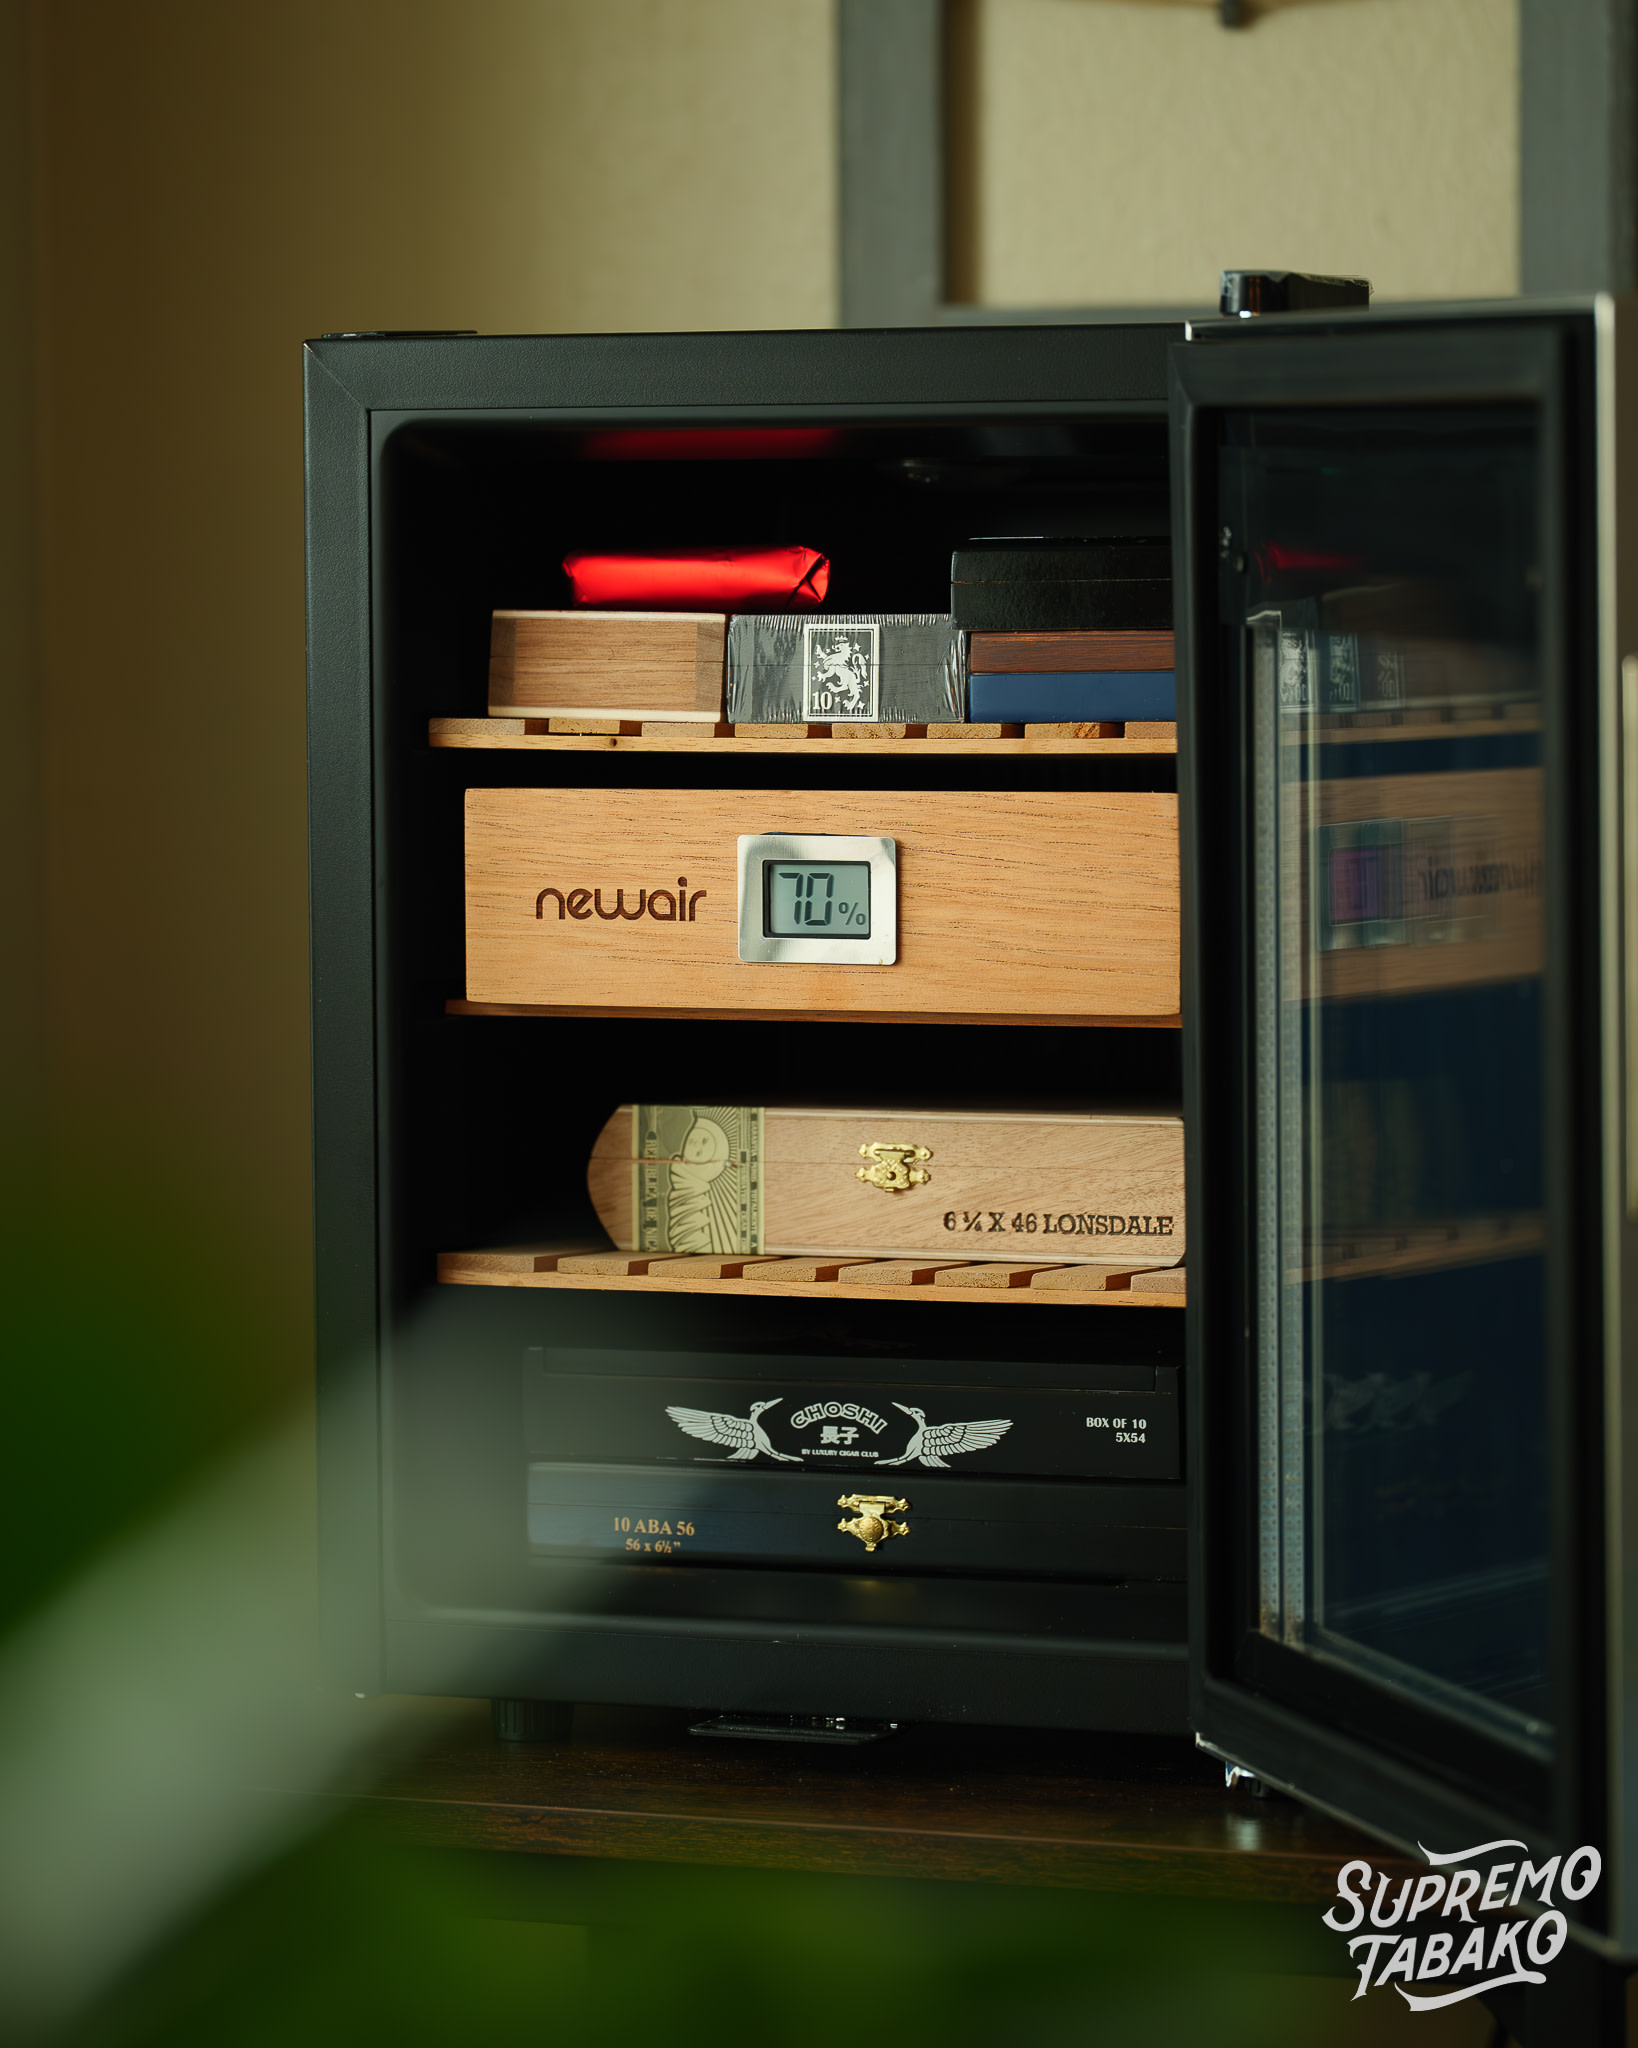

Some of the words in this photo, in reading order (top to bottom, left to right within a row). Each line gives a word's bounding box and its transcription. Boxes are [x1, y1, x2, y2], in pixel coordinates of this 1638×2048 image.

[812, 691, 833, 710] 10
[535, 876, 707, 922] newair
[943, 1210, 957, 1231] 6
[987, 1212, 1006, 1232] X
[1011, 1212, 1038, 1233] 46
[1042, 1213, 1174, 1236] LONSDALE
[790, 1401, 888, 1435] CHOSHI
[1086, 1416, 1110, 1428] BOX
[1112, 1417, 1128, 1429] OF
[1132, 1418, 1147, 1430] 10
[819, 1425, 860, 1445] 長子
[1115, 1431, 1146, 1444] 5X54
[839, 1449, 860, 1457] CIGAR
[860, 1450, 880, 1458] CLUB
[613, 1516, 631, 1533] 10
[633, 1518, 673, 1535] ABA
[675, 1520, 696, 1537] 56
[624, 1537, 641, 1552] 56
